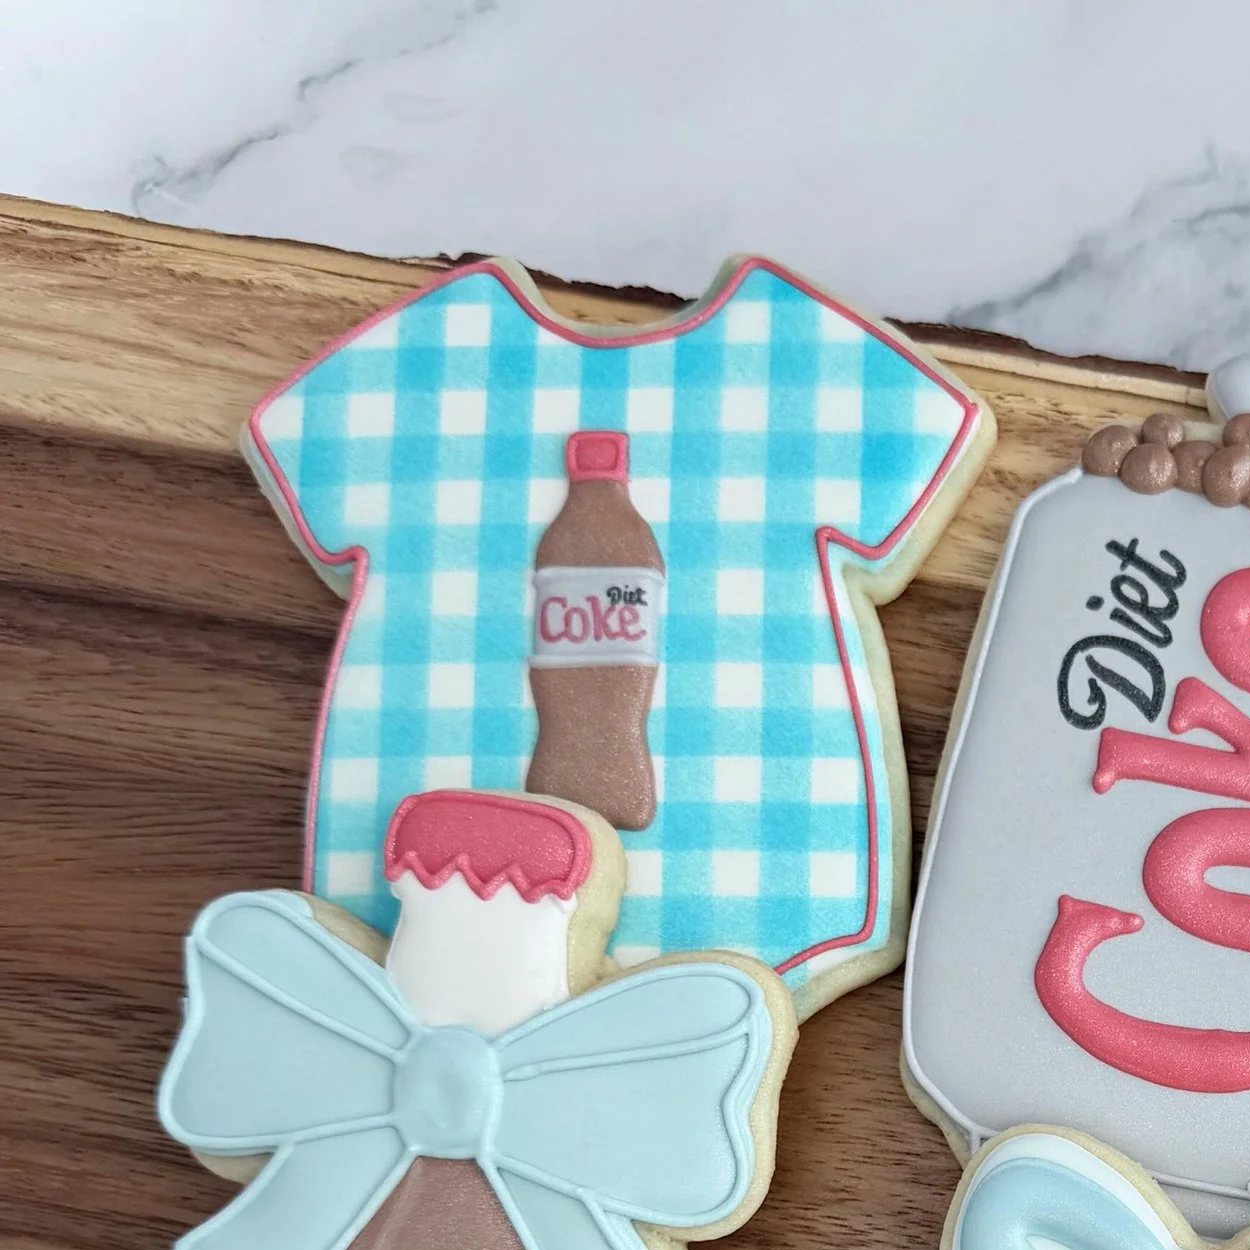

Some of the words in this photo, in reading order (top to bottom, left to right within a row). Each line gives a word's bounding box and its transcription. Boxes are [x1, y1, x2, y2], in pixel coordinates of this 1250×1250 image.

[539, 595, 647, 644] Coke
[606, 585, 648, 607] Diet
[1057, 537, 1188, 732] Diet
